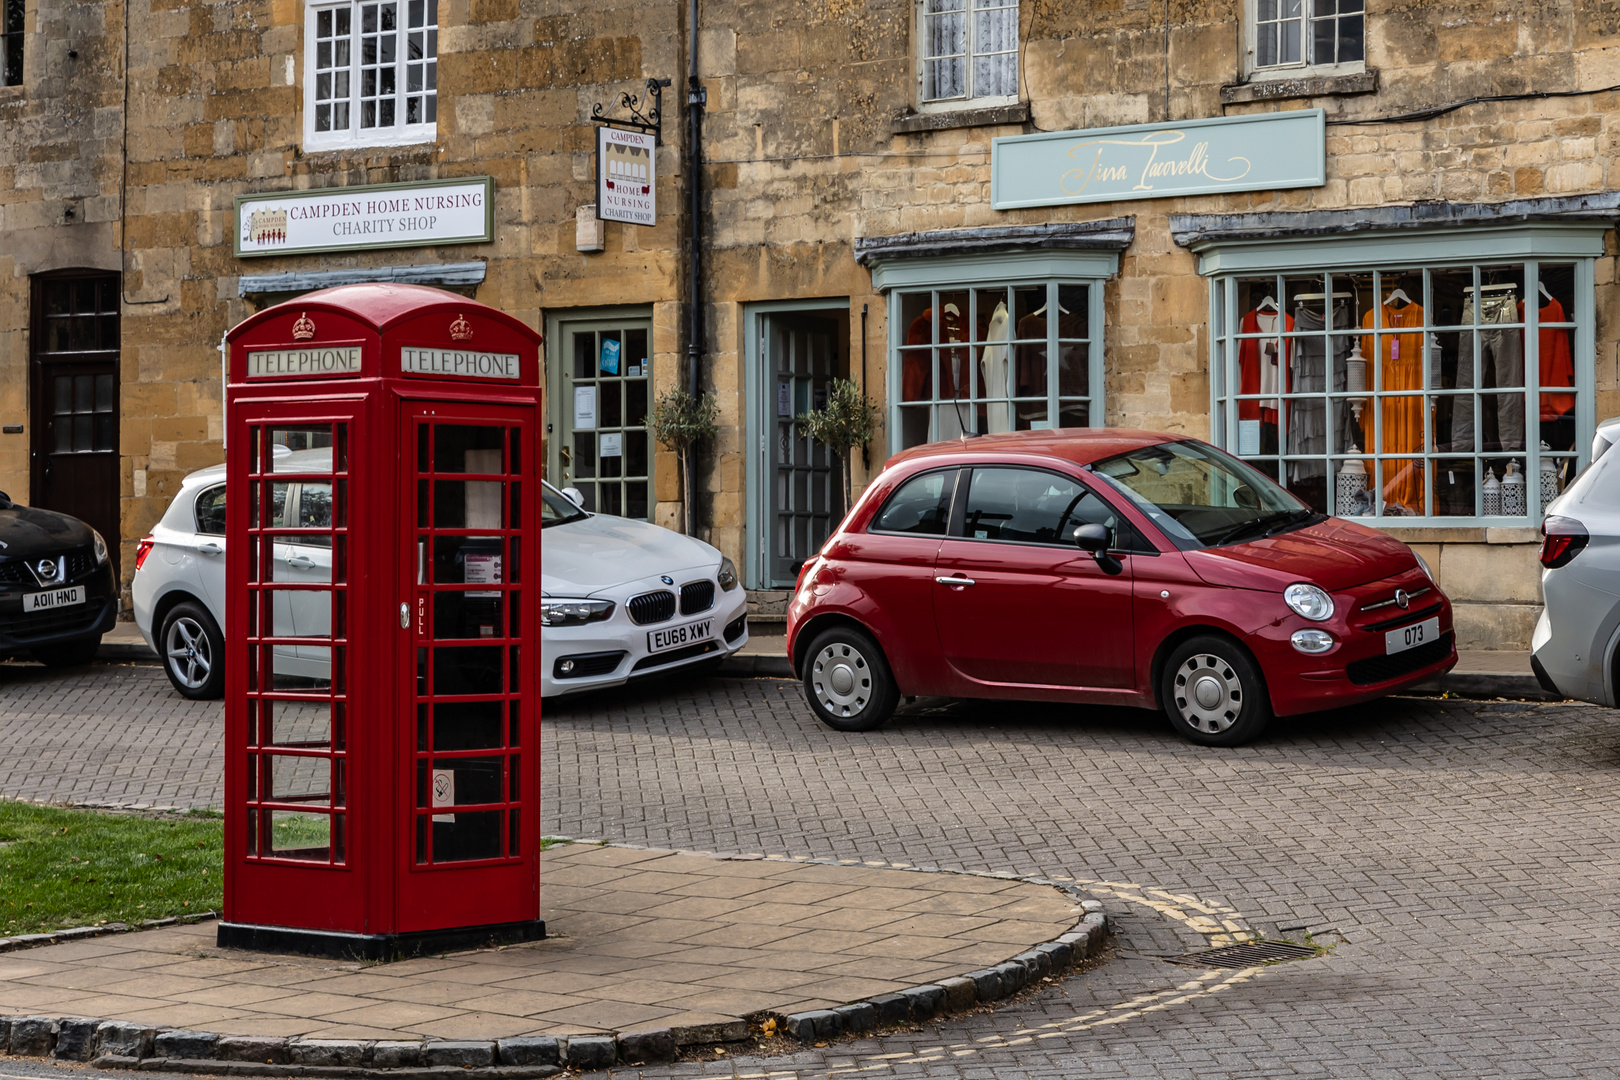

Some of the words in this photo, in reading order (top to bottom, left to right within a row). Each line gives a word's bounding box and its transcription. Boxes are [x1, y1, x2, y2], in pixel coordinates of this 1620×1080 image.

[611, 131, 645, 144] CAMPDEN
[1060, 140, 1129, 195] Tina
[616, 184, 641, 196] HOME
[290, 202, 361, 220] CAMPDEN
[366, 199, 410, 214] HOME
[414, 193, 482, 211] NURSING
[607, 196, 650, 210] NURSING
[258, 216, 287, 224] CAMPDEN
[604, 207, 633, 219] CHARITY
[634, 212, 652, 222] SHOP
[333, 219, 395, 236] CHARITY
[398, 215, 437, 232] SHOP
[253, 349, 358, 374] TELEPHONE
[405, 350, 515, 376] TELEPHONE
[33, 593, 54, 608] AO11
[56, 589, 77, 604] HND
[655, 627, 687, 648] EU68
[689, 620, 711, 640] XWY
[1404, 625, 1424, 646] 073
